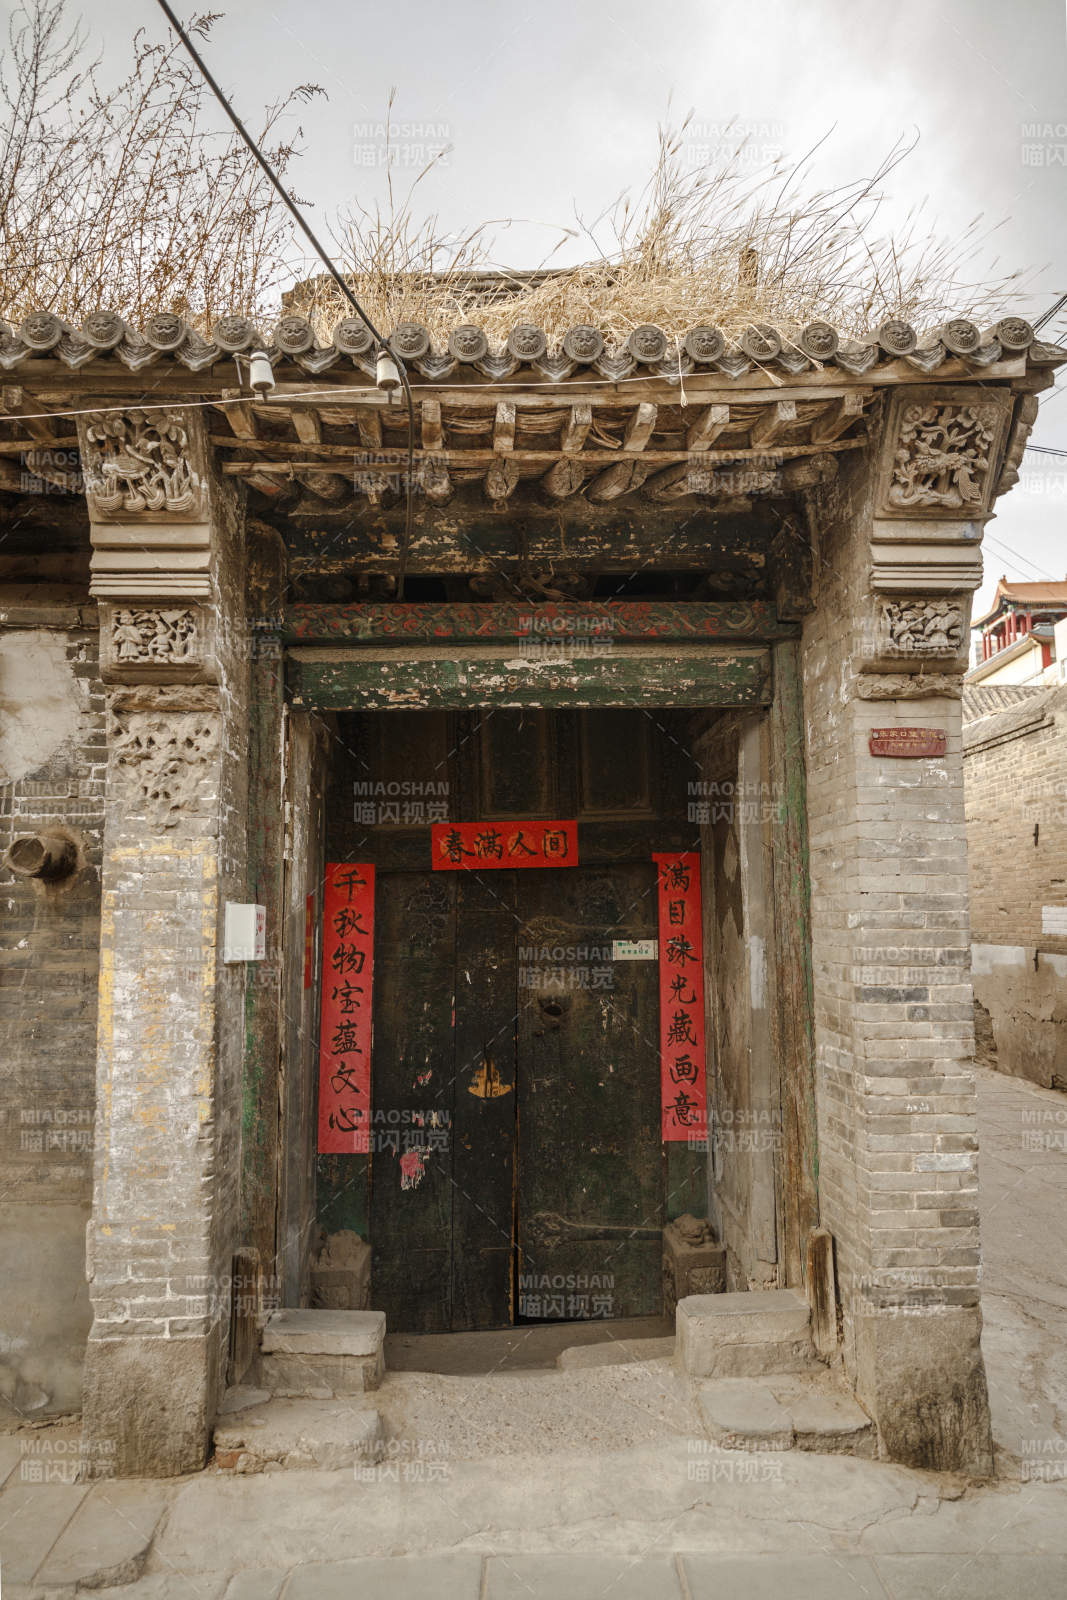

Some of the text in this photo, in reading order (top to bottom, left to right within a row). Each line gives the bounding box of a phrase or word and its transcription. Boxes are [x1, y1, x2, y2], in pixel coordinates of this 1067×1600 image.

[438, 828, 568, 864] 春满人间
[328, 869, 369, 1132] 千秋物宝蕴文心
[661, 861, 700, 1127] 满目珠光藏画意
